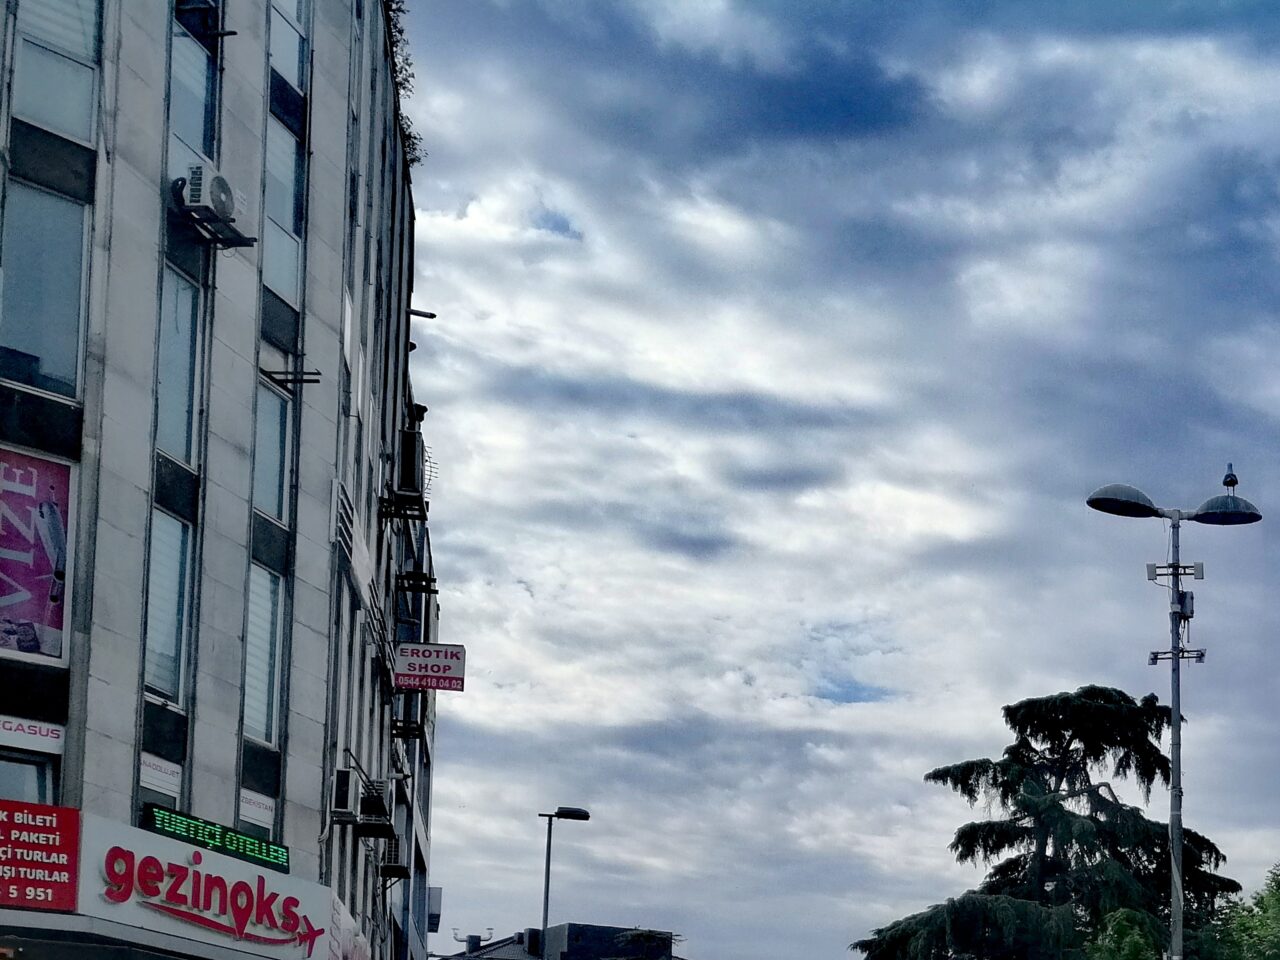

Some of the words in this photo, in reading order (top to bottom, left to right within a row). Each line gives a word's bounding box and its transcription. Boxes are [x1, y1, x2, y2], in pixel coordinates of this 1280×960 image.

[400, 647, 461, 661] EROTİK
[407, 662, 452, 674] SHOP
[398, 676, 420, 687] 0544
[421, 676, 437, 687] 418
[439, 679, 450, 688] 04
[451, 680, 462, 689] 02
[0, 719, 61, 739] GASUS
[14, 809, 57, 828] BİLETİ
[10, 830, 61, 846] PAKETİ
[14, 848, 68, 865] TURLAR
[18, 867, 69, 883] TURLAR
[25, 886, 53, 902] 951
[104, 845, 300, 939] gezinoks
